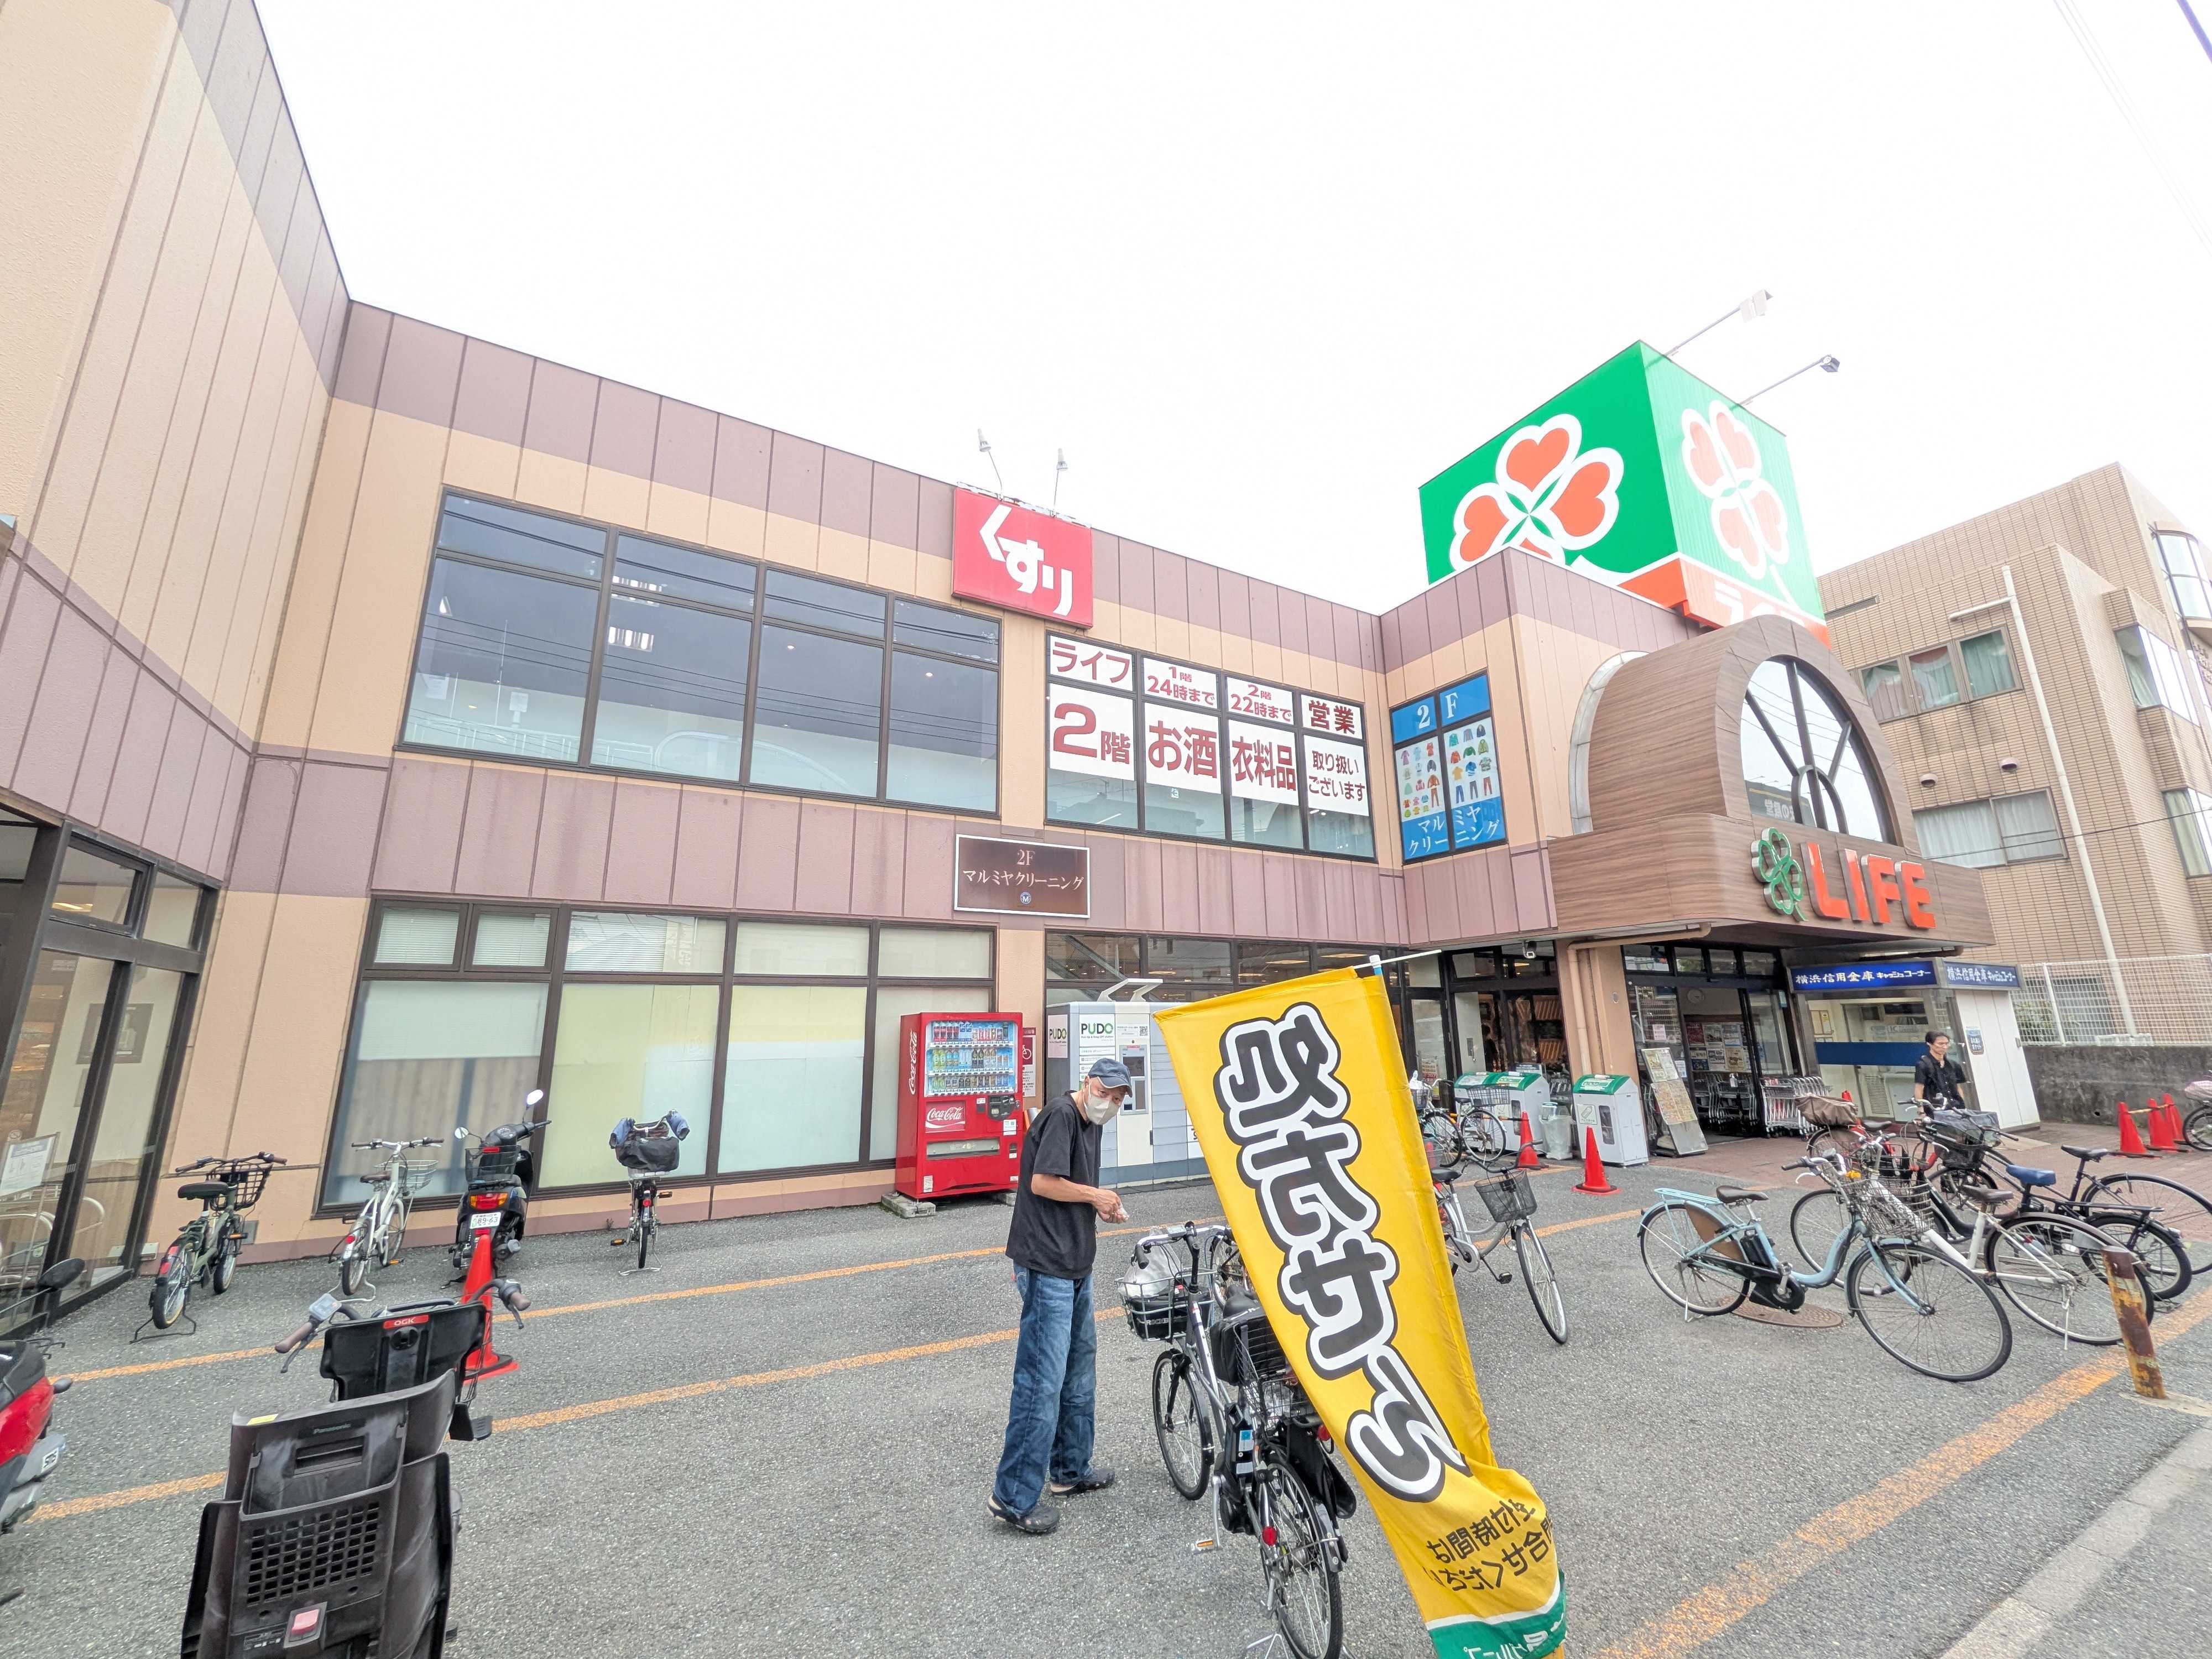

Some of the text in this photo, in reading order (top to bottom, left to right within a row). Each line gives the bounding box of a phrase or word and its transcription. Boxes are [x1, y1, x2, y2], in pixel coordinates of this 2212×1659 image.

[979, 503, 1073, 617] くすり
[1052, 641, 1130, 683] ライフ
[1168, 666, 1192, 682] 1階
[1147, 675, 1215, 706] 24時まで
[1248, 684, 1272, 700] 2階
[1230, 693, 1292, 722] 22時まで
[1308, 700, 1355, 735] 営業
[1053, 703, 1131, 764] 2階
[1148, 720, 1217, 779] お酒
[1312, 750, 1359, 775] 取り扱い
[1232, 736, 1296, 791] 衣料品
[1308, 775, 1366, 802] ございます
[1418, 806, 1481, 833] マルミヤ
[1408, 819, 1500, 856] クリーニング
[1016, 849, 1036, 866] 2F
[963, 869, 1084, 890] マルミヤクリーニング
[1803, 840, 1937, 929] LIFE
[1048, 1027, 1067, 1040] PUDO
[1081, 1022, 1114, 1035] PUDO
[908, 1028, 917, 1095] Coca-Cola
[926, 1106, 964, 1122] Coca-Cola
[394, 1317, 416, 1326] OGK
[313, 1423, 351, 1434] Panasonic
